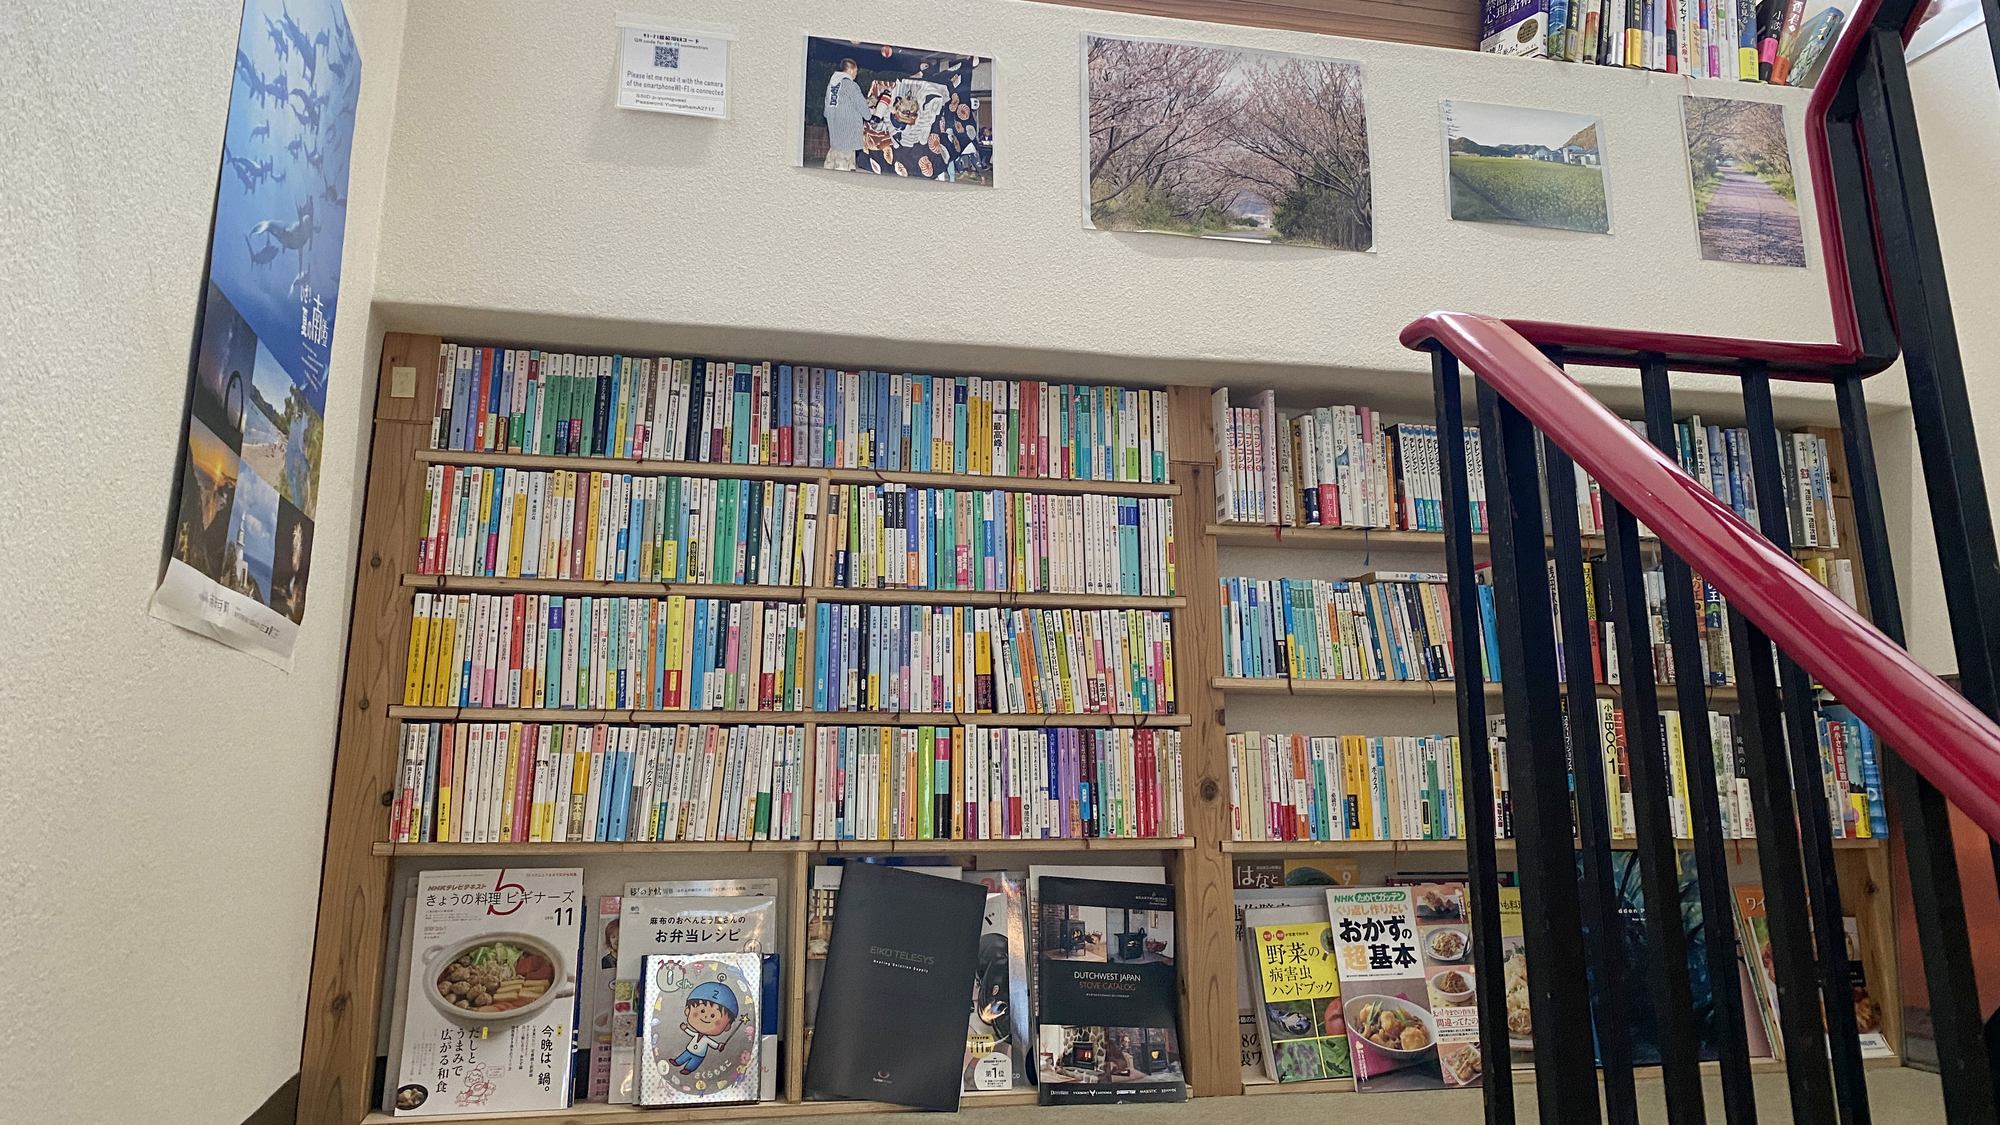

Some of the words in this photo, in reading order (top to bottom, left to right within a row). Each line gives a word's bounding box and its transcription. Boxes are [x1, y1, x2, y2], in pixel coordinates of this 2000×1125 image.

[627, 70, 645, 80] Please
[663, 75, 676, 83] read
[694, 78, 703, 86] the
[704, 80, 723, 88] camera
[696, 88, 724, 96] connected
[426, 892, 501, 907] きょうの料理
[506, 890, 575, 904] ビギナーズ
[1334, 895, 1355, 903] NHK
[554, 907, 573, 926] 11
[1336, 903, 1408, 916] くり返し作りたい
[655, 928, 741, 944] お弁当レシピ
[1339, 914, 1413, 943] おかずの
[870, 945, 893, 957] EIKO
[894, 950, 935, 965] TELESYS
[1266, 942, 1320, 966] 野菜の
[1073, 971, 1119, 981] DUTCHWEST
[1119, 973, 1141, 983] JAPAN
[1269, 965, 1313, 982] 病害虫
[1079, 981, 1100, 990] STOVE
[1102, 982, 1136, 991] CATALOG
[1272, 981, 1333, 996] ハンドブック
[452, 1029, 466, 1077] うまみで
[467, 1028, 480, 1064] だしと
[436, 1028, 452, 1094] 広がる和食
[537, 1024, 555, 1092] 今晩は、鍋。
